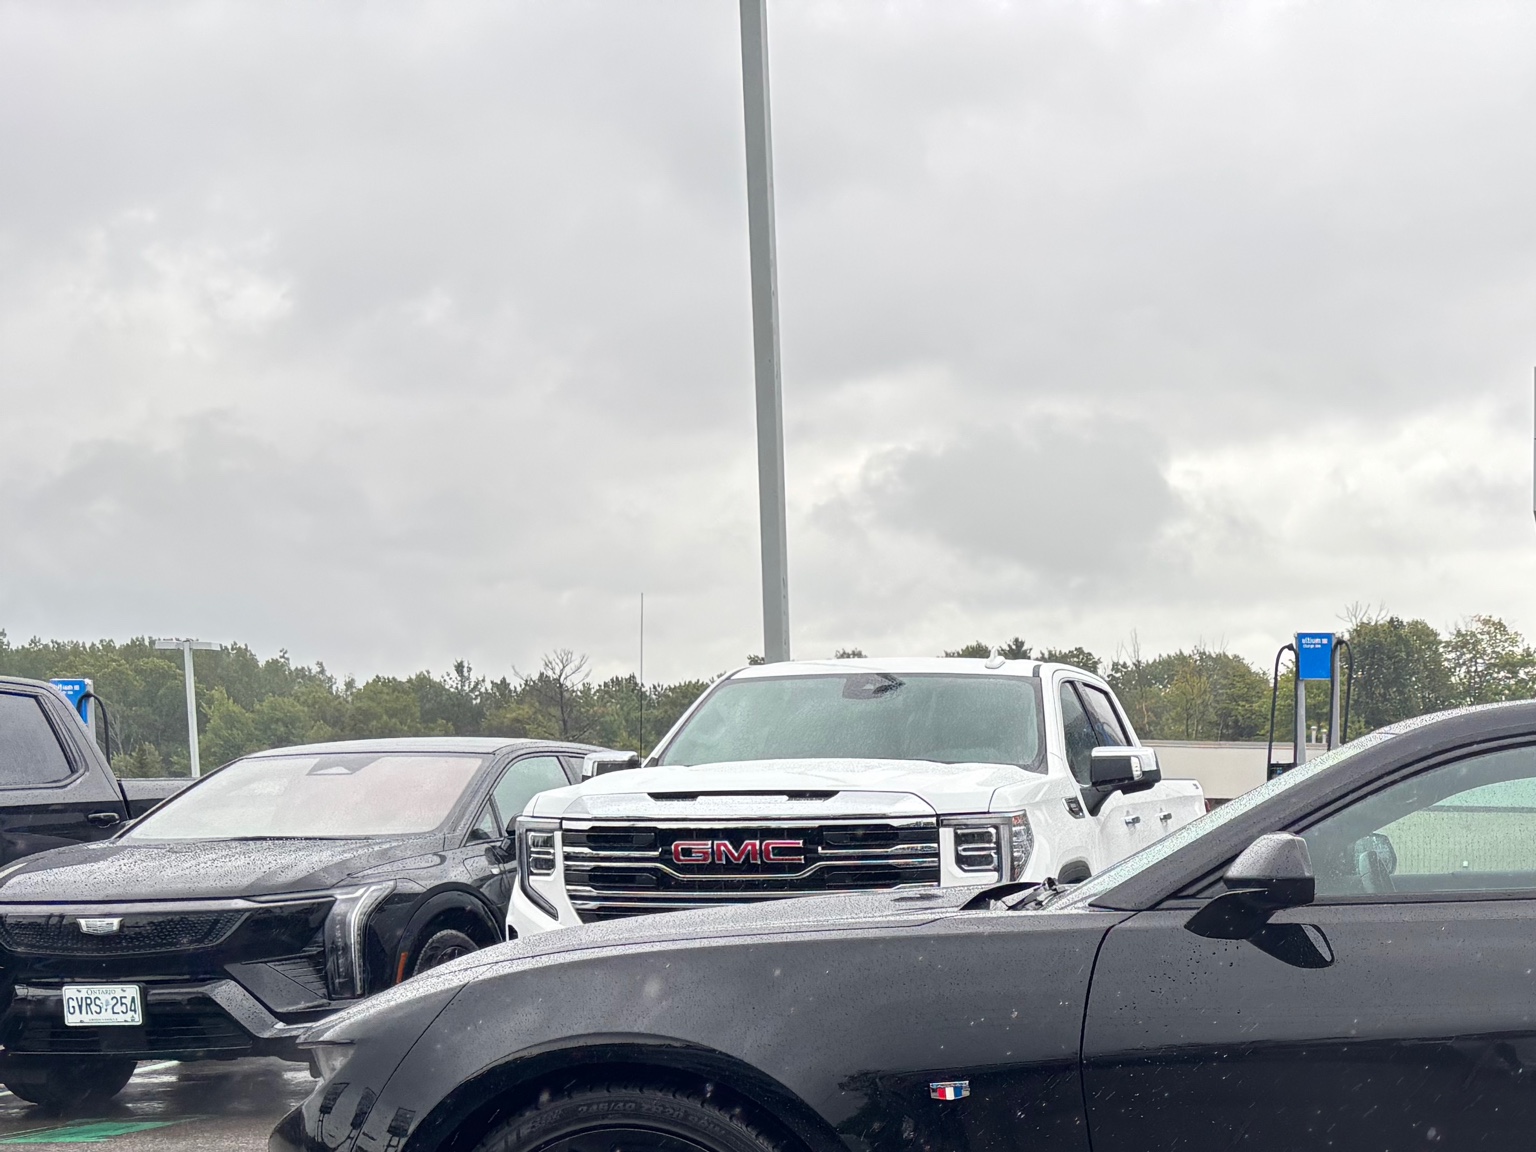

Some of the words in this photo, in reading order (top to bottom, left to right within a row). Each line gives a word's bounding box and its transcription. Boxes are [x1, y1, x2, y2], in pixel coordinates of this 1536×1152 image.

[671, 839, 805, 865] GMC
[67, 996, 102, 1015] GVRS
[110, 995, 137, 1015] 254
